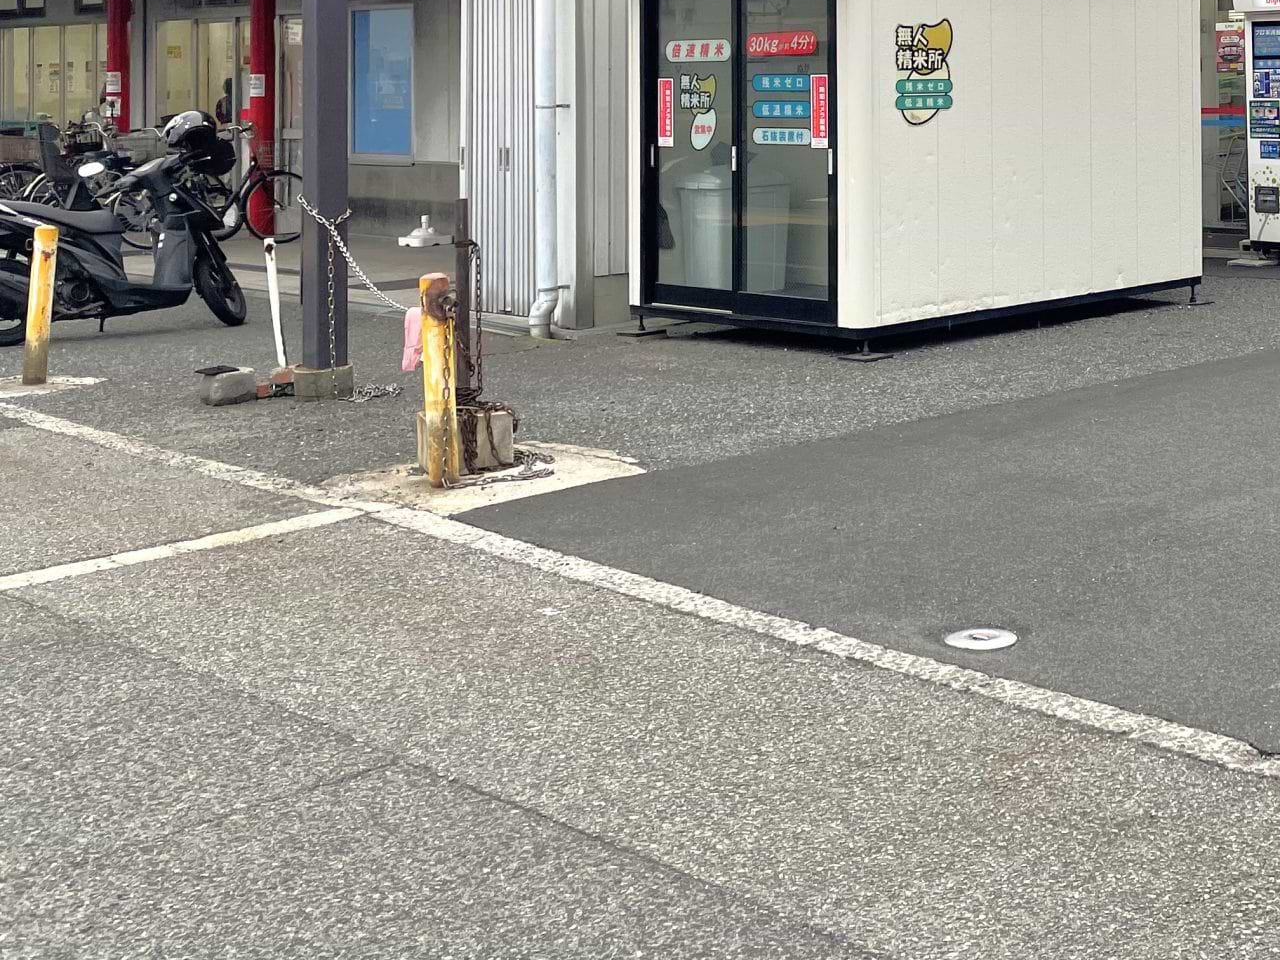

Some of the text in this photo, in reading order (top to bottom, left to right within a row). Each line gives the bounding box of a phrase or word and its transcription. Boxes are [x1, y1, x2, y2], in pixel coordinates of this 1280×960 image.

[896, 26, 928, 47] 無人
[672, 42, 725, 58] 倍速精米
[896, 50, 943, 70] 精米所
[681, 74, 700, 90] 無人
[681, 92, 710, 109] 精米所
